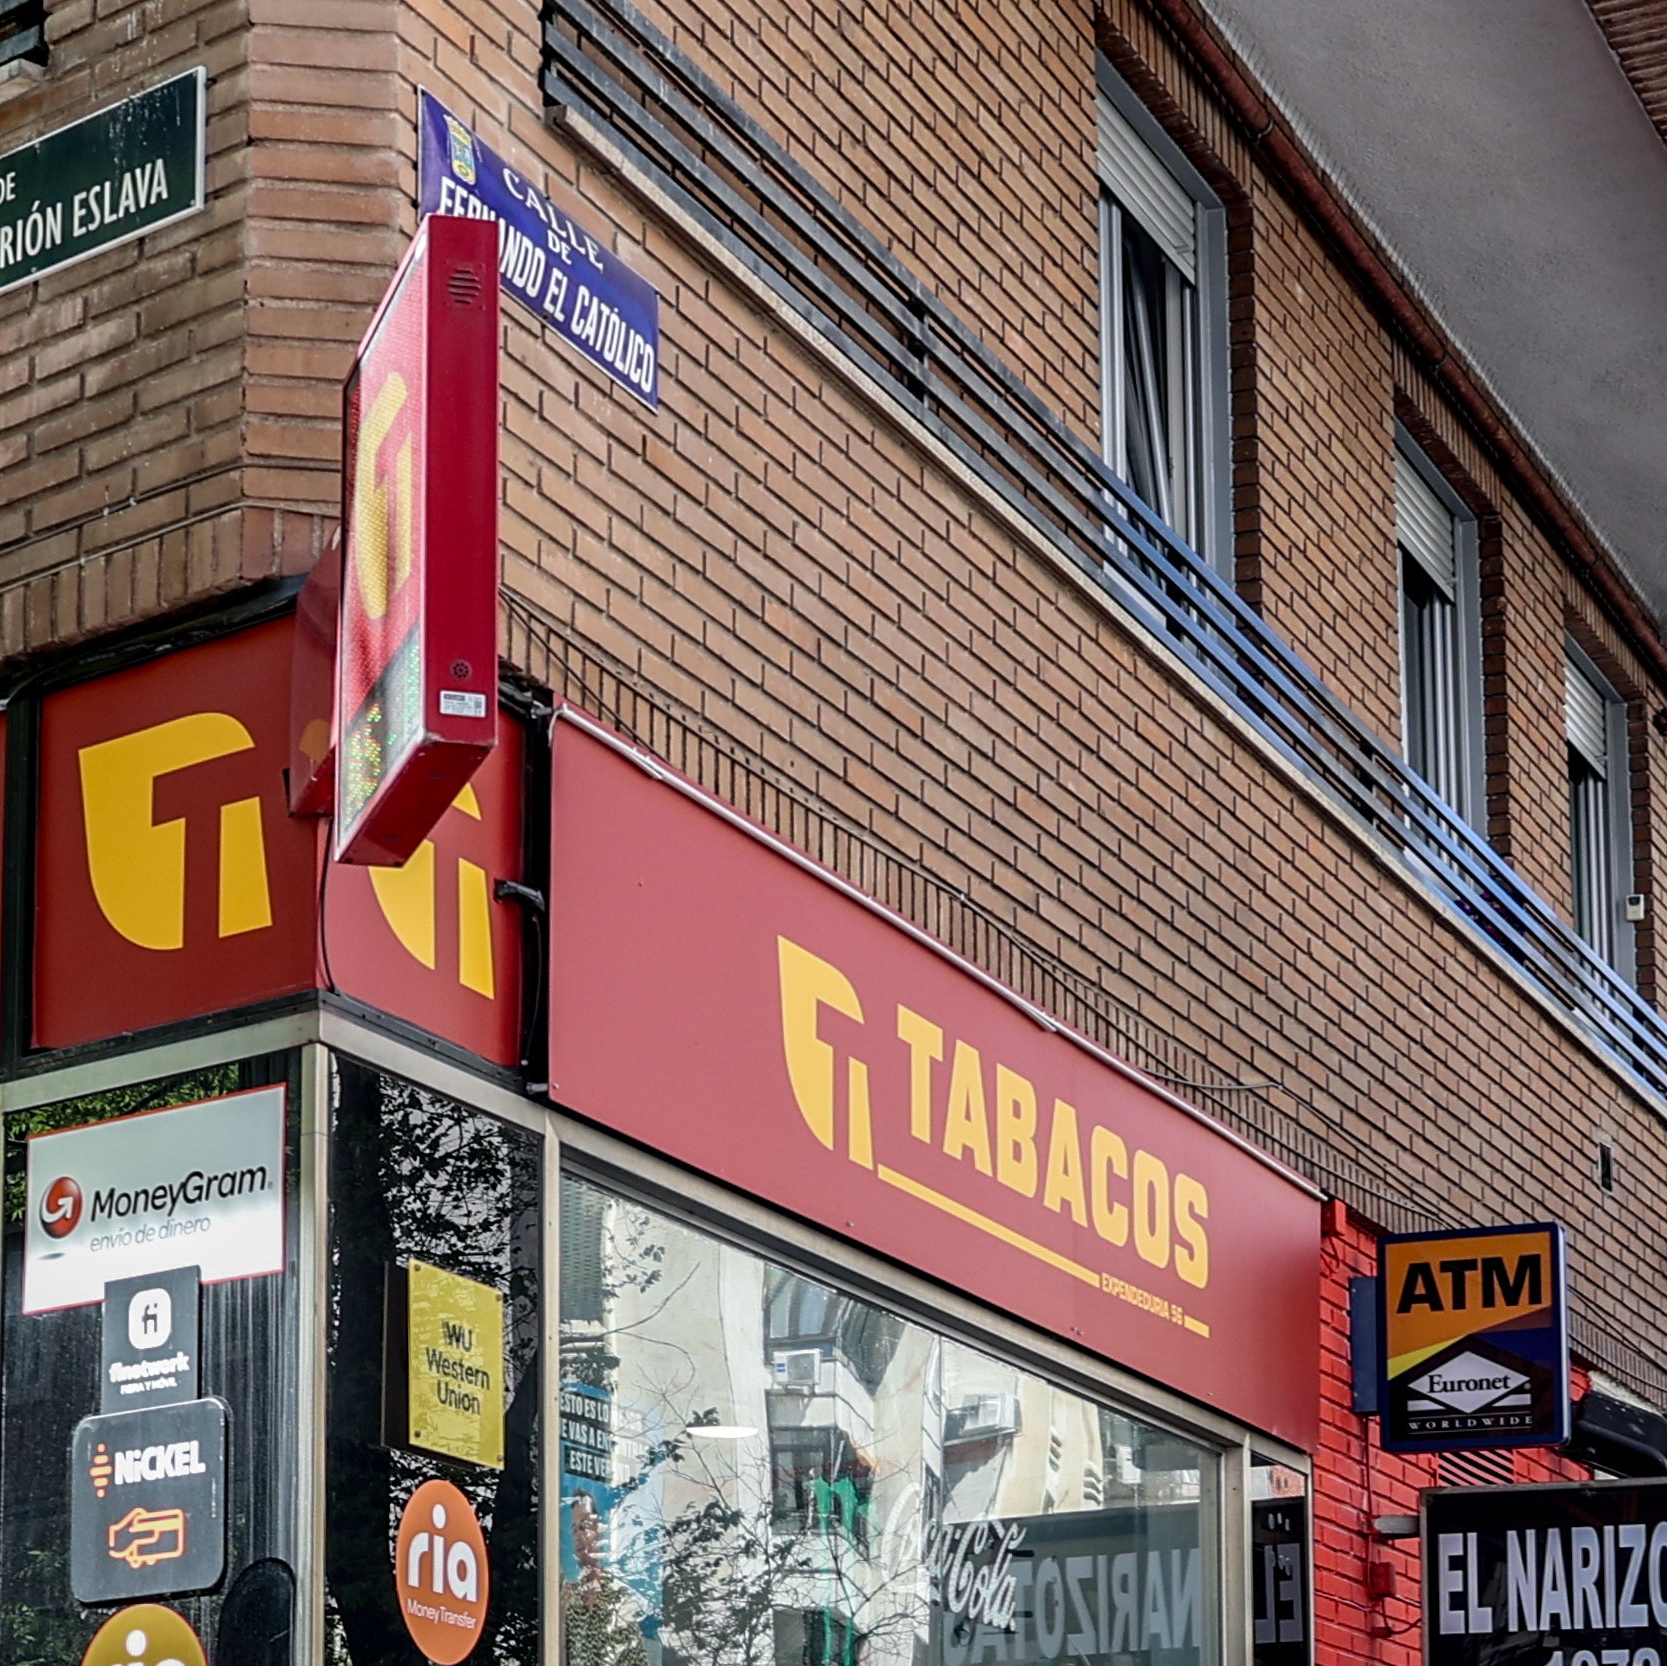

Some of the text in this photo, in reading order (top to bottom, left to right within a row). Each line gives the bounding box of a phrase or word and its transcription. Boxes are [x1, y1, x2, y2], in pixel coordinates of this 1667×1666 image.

[73, 158, 168, 238] ESLAVA
[502, 168, 604, 271] CALLE
[547, 230, 572, 264] DE
[543, 266, 567, 321] EL
[570, 287, 654, 393] CATÓLICO
[897, 1003, 1209, 1290] TABACOS
[90, 1165, 267, 1222] MoneyGram
[90, 1216, 211, 1252] envío de dinero
[1396, 1253, 1542, 1314] ATM
[110, 1351, 190, 1383] finetwork
[425, 1346, 490, 1391] Western
[1427, 1373, 1511, 1394] Euronet
[437, 1379, 481, 1415] Union
[584, 1397, 596, 1421] ES
[598, 1401, 610, 1423] LO
[568, 1420, 589, 1448] VAS
[588, 1428, 595, 1447] A
[1409, 1415, 1533, 1432] WORLDWIDE
[570, 1452, 593, 1474] ESTE
[407, 1503, 478, 1603] ria
[1438, 1532, 1492, 1636] EL
[407, 1598, 476, 1630] Money Transfer
